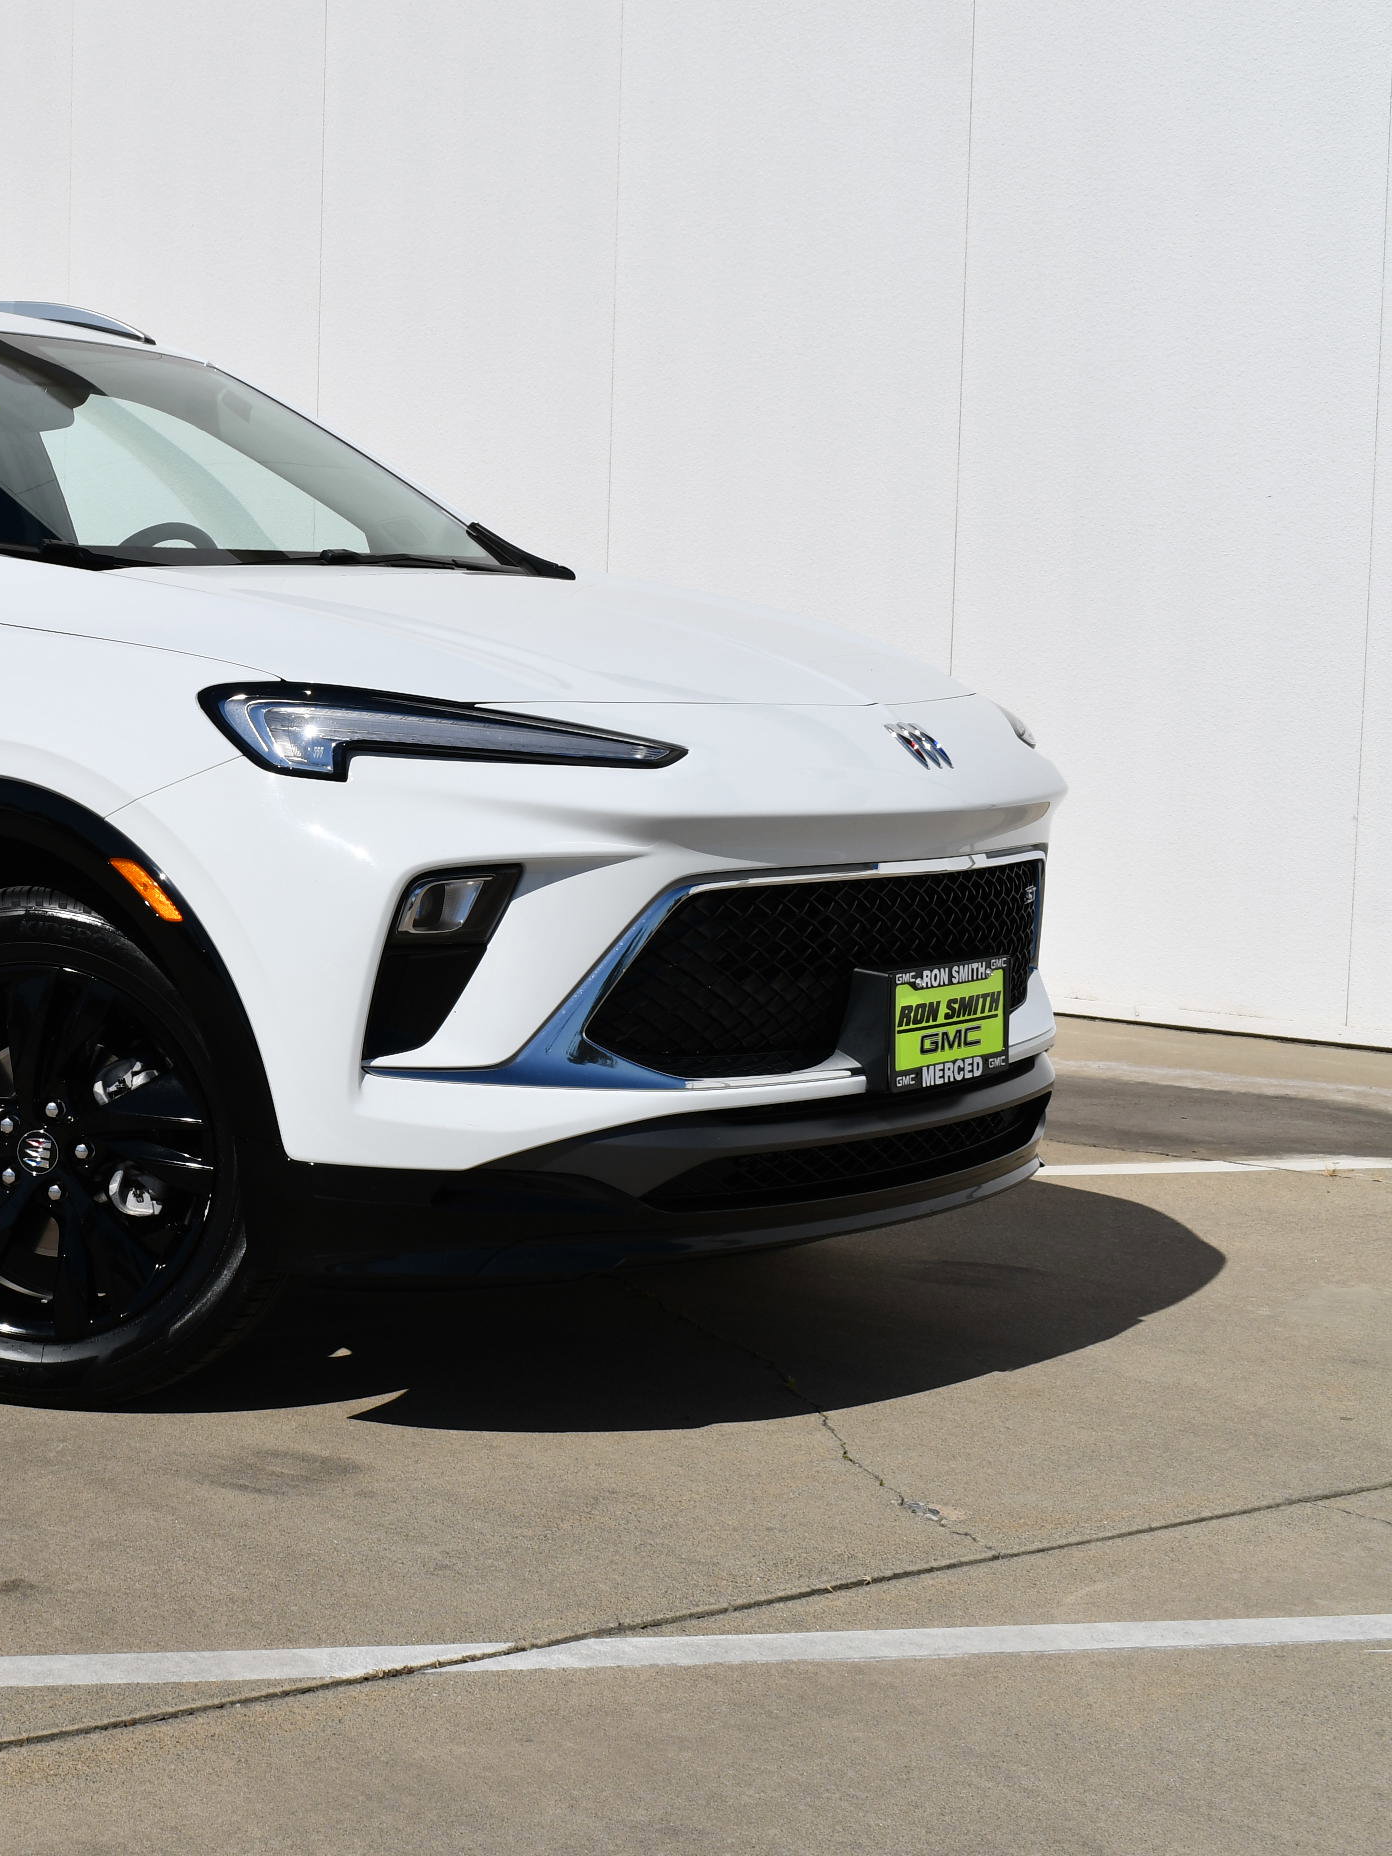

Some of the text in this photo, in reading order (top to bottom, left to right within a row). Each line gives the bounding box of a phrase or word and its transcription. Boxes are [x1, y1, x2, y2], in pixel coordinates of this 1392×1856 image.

[990, 957, 1007, 969] GMC
[895, 972, 916, 984] GMC
[922, 962, 986, 988] RON SMITH
[897, 990, 1001, 1028] RON SMITH
[920, 1024, 981, 1055] GMC
[988, 1056, 1006, 1068] GMC
[896, 1074, 916, 1087] GMC
[922, 1056, 983, 1088] MERCED
